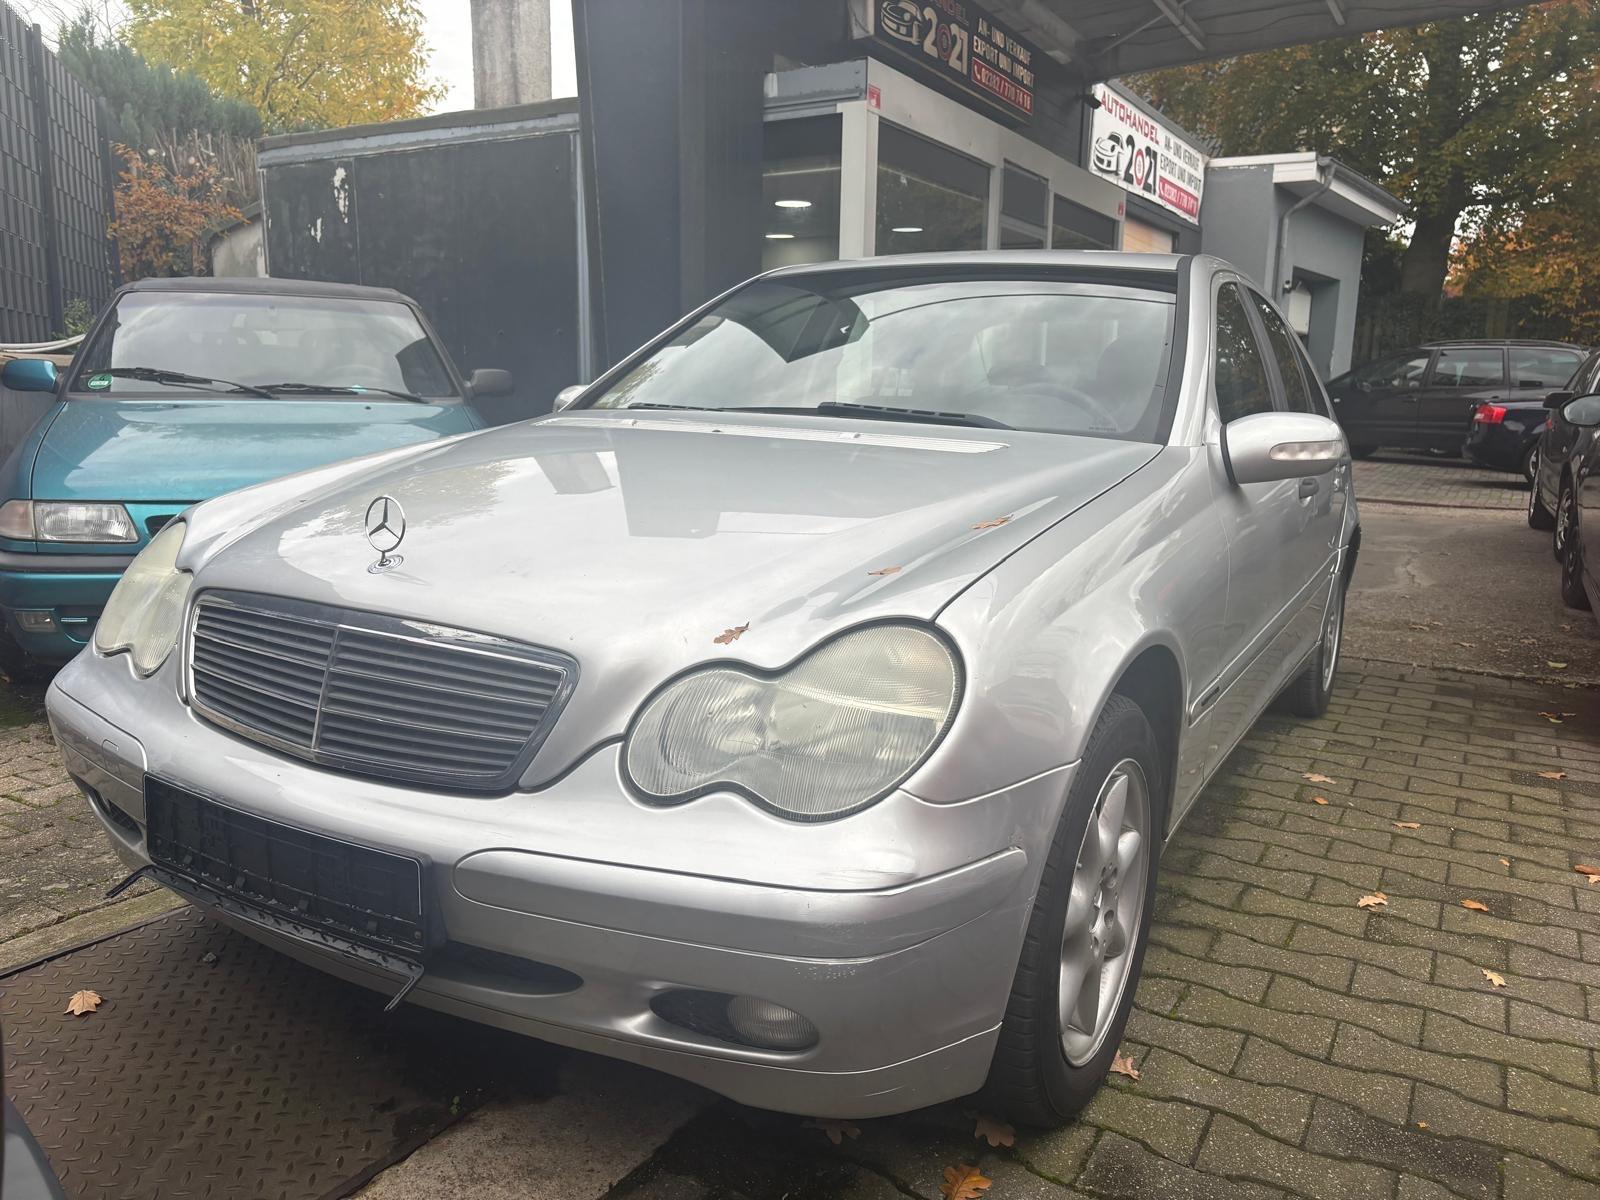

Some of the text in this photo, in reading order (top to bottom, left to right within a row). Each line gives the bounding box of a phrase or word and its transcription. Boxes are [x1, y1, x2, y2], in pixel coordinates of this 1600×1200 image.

[923, 6, 969, 76] 2021
[973, 36, 1034, 88] EXPORT UND IMPORT
[991, 27, 1006, 49] UND
[1006, 35, 1032, 66] VERKAUF
[1100, 90, 1160, 145] AUTOHANDEL
[1124, 134, 1158, 196] 2021
[1160, 153, 1202, 193] EXPORT UND IMPORT
[1173, 140, 1182, 160] UND
